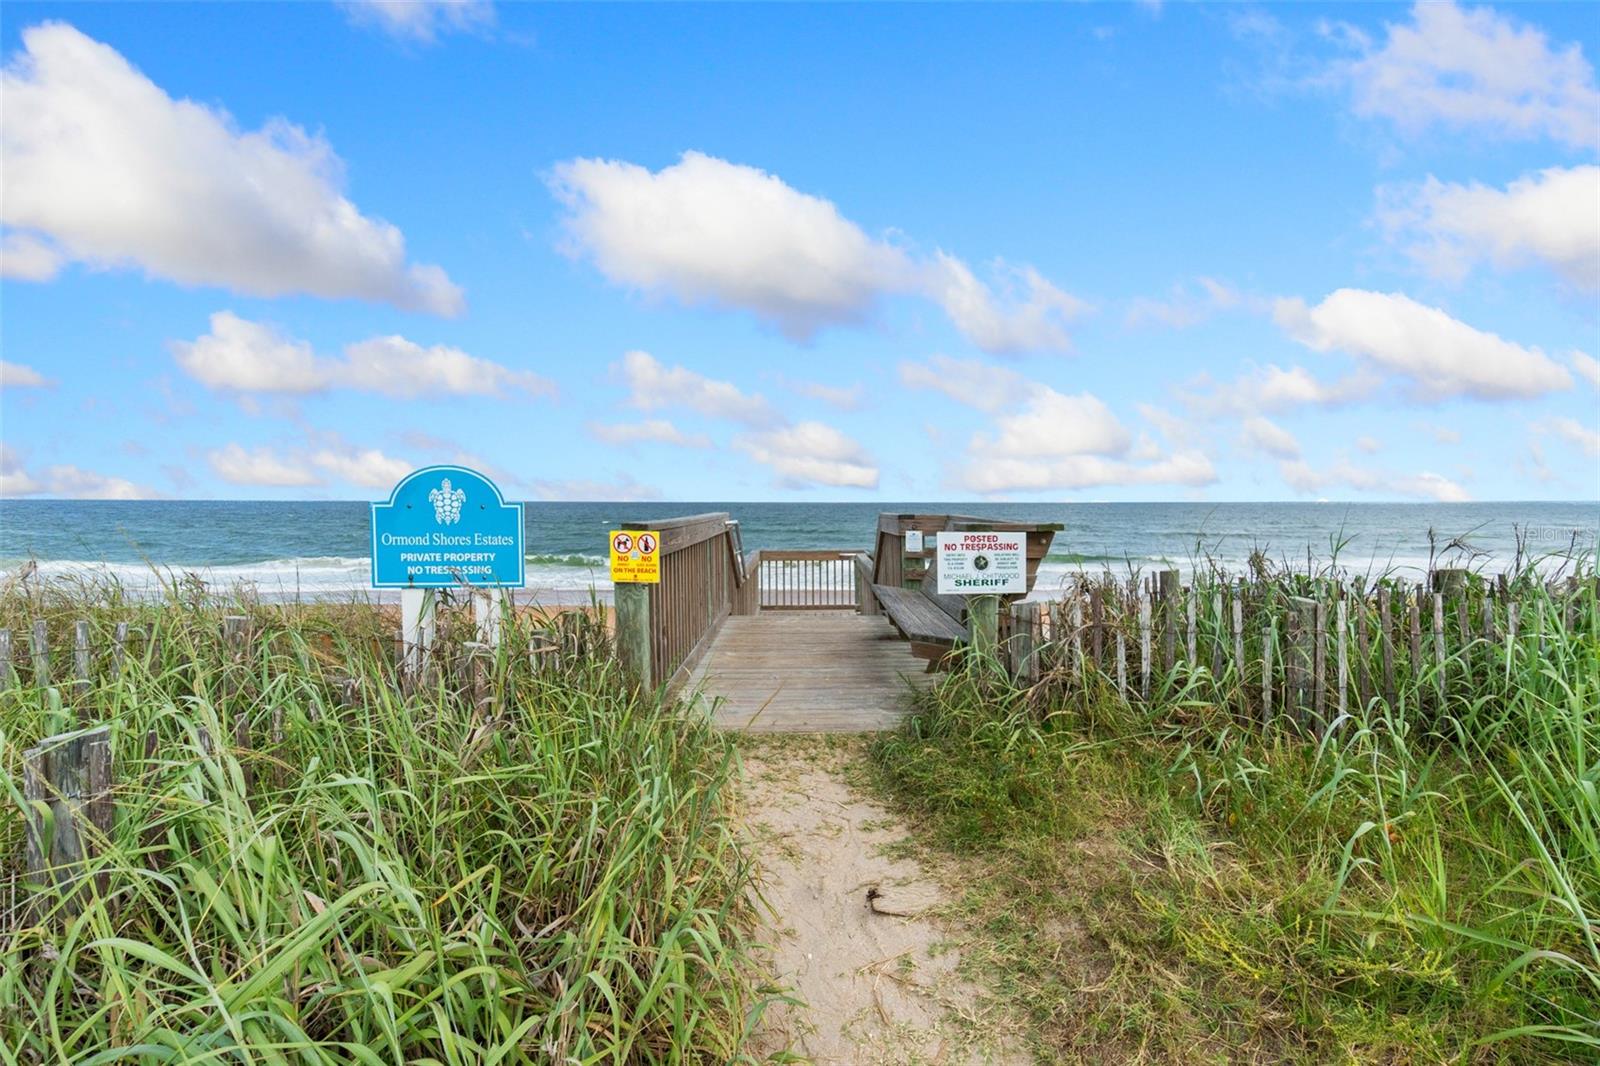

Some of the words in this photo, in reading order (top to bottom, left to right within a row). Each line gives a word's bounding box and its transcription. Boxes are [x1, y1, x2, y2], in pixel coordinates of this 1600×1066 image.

[381, 532, 430, 546] Ormond
[432, 532, 472, 546] Shores
[474, 532, 514, 546] Estates
[964, 535, 998, 543] POSTED
[944, 543, 957, 551] NO
[960, 543, 1019, 551] TRESPASSING
[400, 553, 442, 562] PRIVATE
[443, 553, 496, 562] PROPERTY
[407, 565, 423, 575] NO
[954, 579, 1009, 587] SHERIFF
